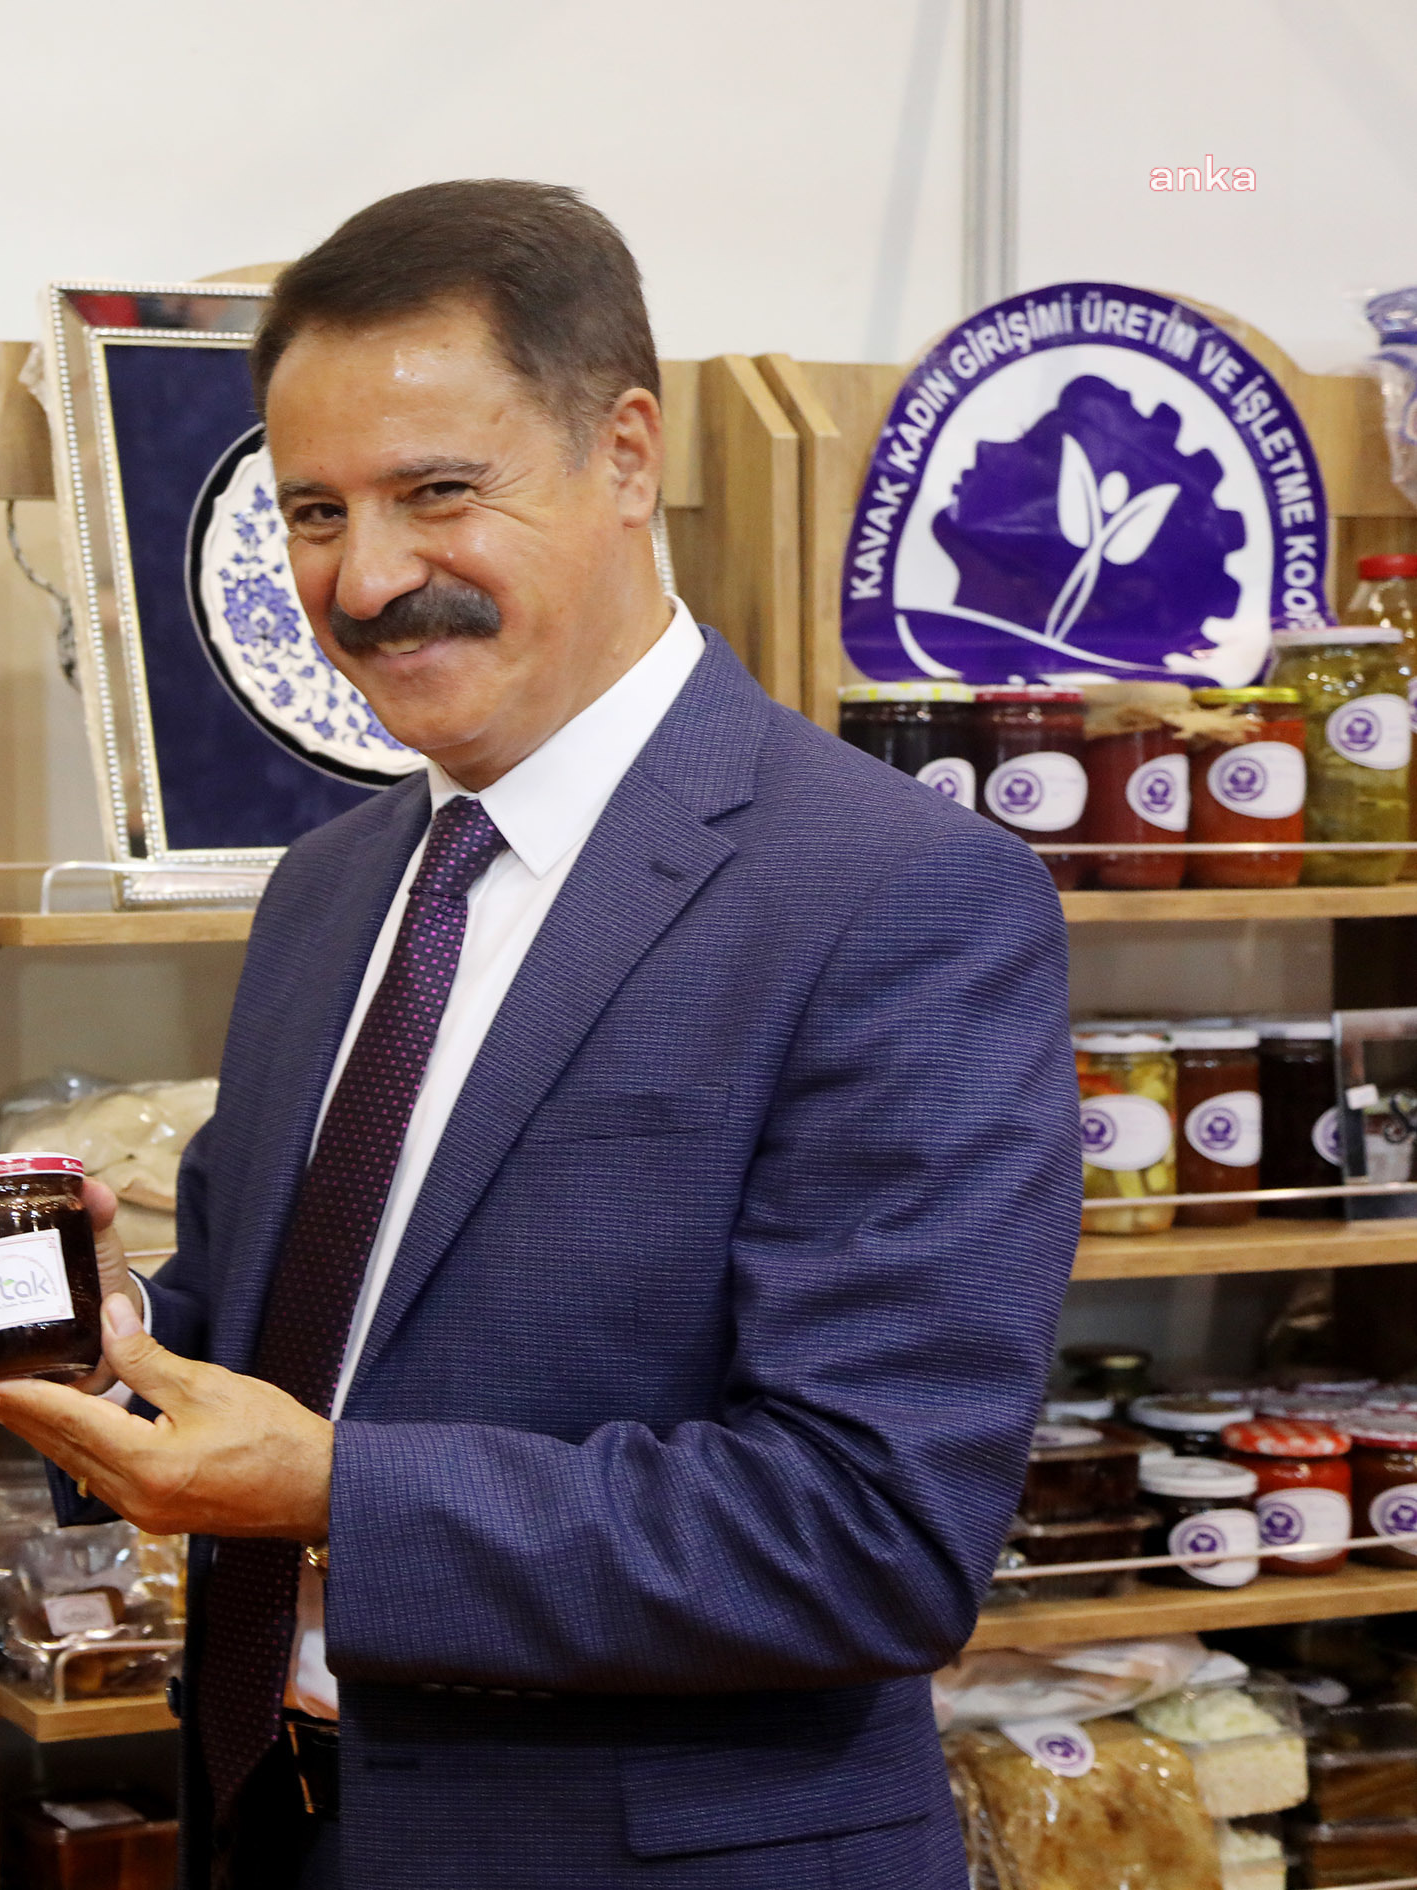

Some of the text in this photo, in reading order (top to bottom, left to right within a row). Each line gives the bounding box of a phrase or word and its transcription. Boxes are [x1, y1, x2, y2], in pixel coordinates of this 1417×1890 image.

[850, 475, 909, 601] KAVAK
[887, 368, 957, 474] KADIN
[949, 291, 1073, 379] GİRİŞİMİ
[1081, 291, 1199, 362] ÜRETİM
[1197, 338, 1243, 395] VE
[1232, 374, 1315, 529] İŞLETME
